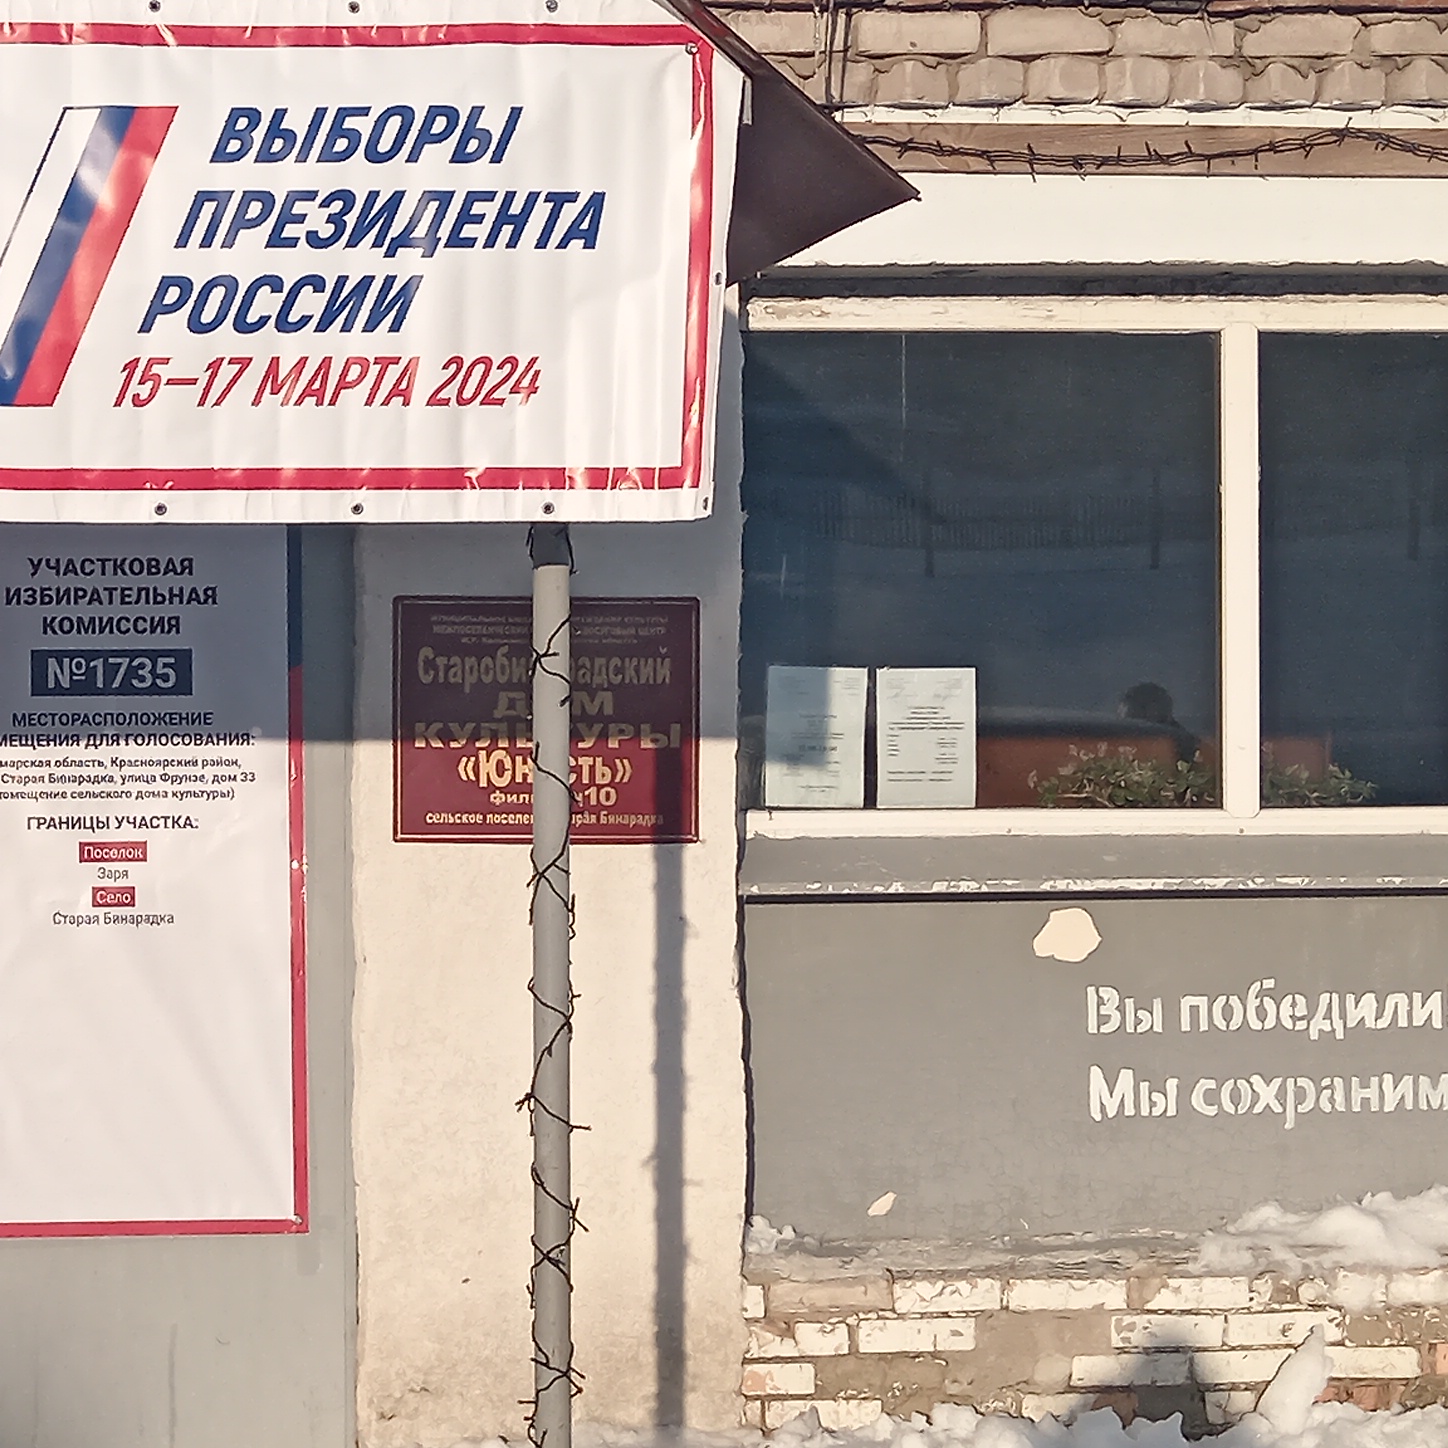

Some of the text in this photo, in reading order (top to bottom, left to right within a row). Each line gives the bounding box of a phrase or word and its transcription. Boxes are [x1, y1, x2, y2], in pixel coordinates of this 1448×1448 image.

[210, 105, 523, 165] ВЫБОРЫ
[173, 189, 606, 258] ПРЕЗИДЕНТА
[138, 274, 422, 335] РОССИИ
[253, 356, 420, 408] МАРТА
[425, 356, 541, 406] 2024
[27, 557, 194, 578] УЧАСТКОВАЯ
[5, 586, 218, 606] ИЗБИРАТЕЛЬНАЯ
[41, 615, 181, 635] КОМИССИЯ
[47, 656, 177, 690] №1735
[418, 645, 672, 693] Старобиадский
[493, 690, 614, 719] ДМ
[12, 712, 214, 727] МЕСТОРАСПОЛОЖЕНИЕ
[85, 733, 121, 749] ДЛЯ
[124, 733, 256, 747] ГОЛОСОВАНИЯ:
[414, 722, 681, 749] КУЛУРЫ
[54, 756, 108, 770] область,
[110, 756, 198, 771] Красноярский
[458, 749, 633, 788] «Юнть»
[0, 774, 45, 786] Старая
[120, 774, 157, 786] улица
[212, 774, 237, 785] дом
[240, 772, 256, 783] 33
[71, 789, 133, 800] сельского
[135, 789, 168, 800] дома
[172, 788, 235, 801] культуры)
[27, 815, 199, 833] ГРАНИЦЫ УЧАСТКА:
[426, 811, 483, 825] сельское
[84, 846, 143, 859] Поселок
[97, 867, 129, 882] Заря
[96, 890, 131, 904] Село
[53, 912, 174, 929] Старая Бинарадка
[1086, 985, 1163, 1034] Вы
[1088, 1064, 1180, 1122] Мы
